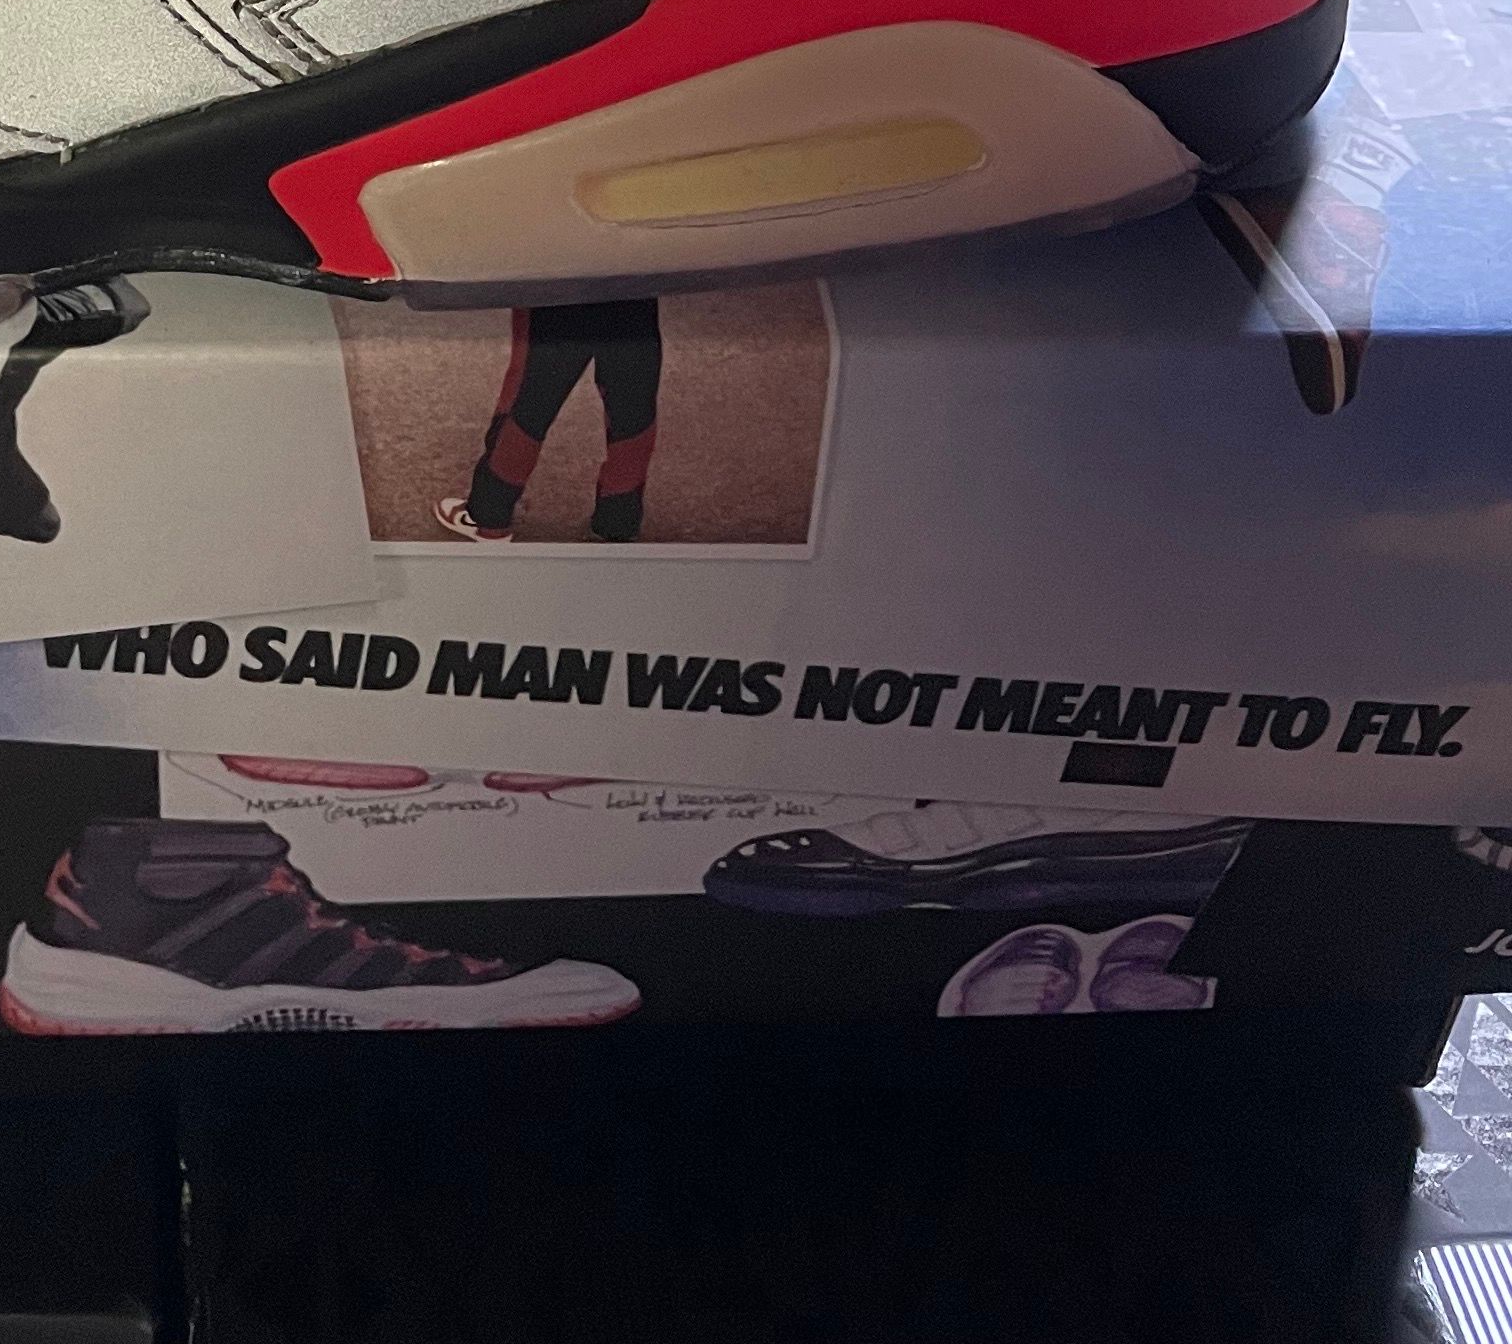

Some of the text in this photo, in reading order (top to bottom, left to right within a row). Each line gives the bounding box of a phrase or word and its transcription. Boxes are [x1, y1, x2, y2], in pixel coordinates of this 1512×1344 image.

[43, 621, 1471, 757] WHO SAID MAN WAS NOT MEANT TO FLY.
